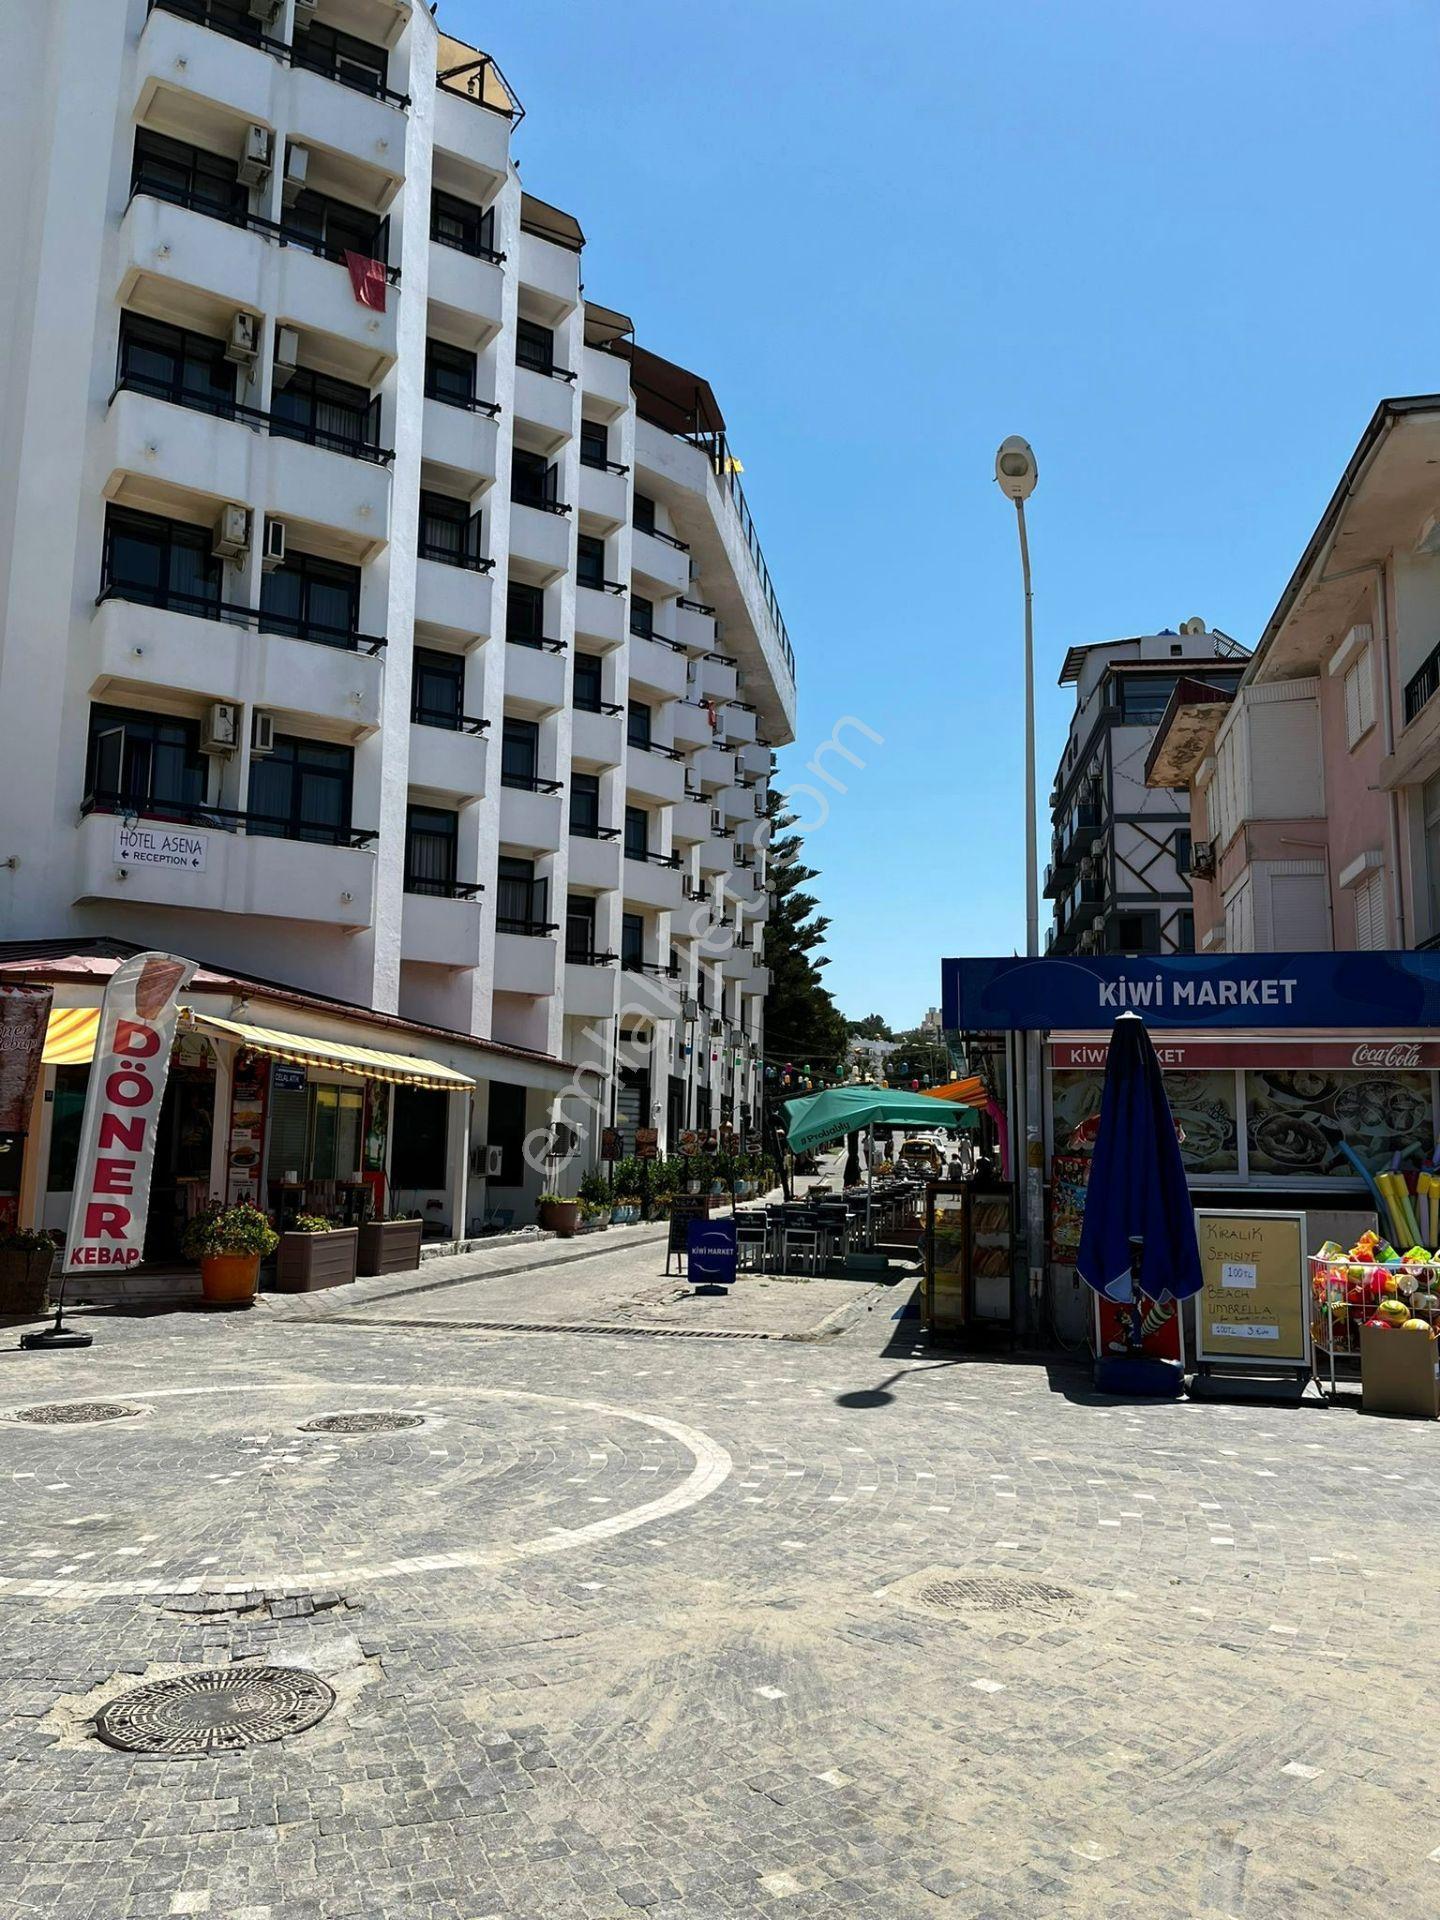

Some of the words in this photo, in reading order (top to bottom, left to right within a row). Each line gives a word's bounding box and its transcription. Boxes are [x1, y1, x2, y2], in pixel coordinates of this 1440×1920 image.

[120, 830, 156, 850] HOTEL
[161, 836, 202, 856] ASENA
[133, 851, 188, 866] RECEPTION
[1100, 974, 1163, 1006] KİWİ
[1173, 979, 1298, 1005] MARKET
[1352, 1043, 1423, 1067] Coca-Cola
[83, 1018, 161, 1240] DÖNER
[70, 1246, 140, 1266] KEBAP
[1207, 1284, 1250, 1299] BEACH
[1208, 1304, 1273, 1315] UMBRELLA
